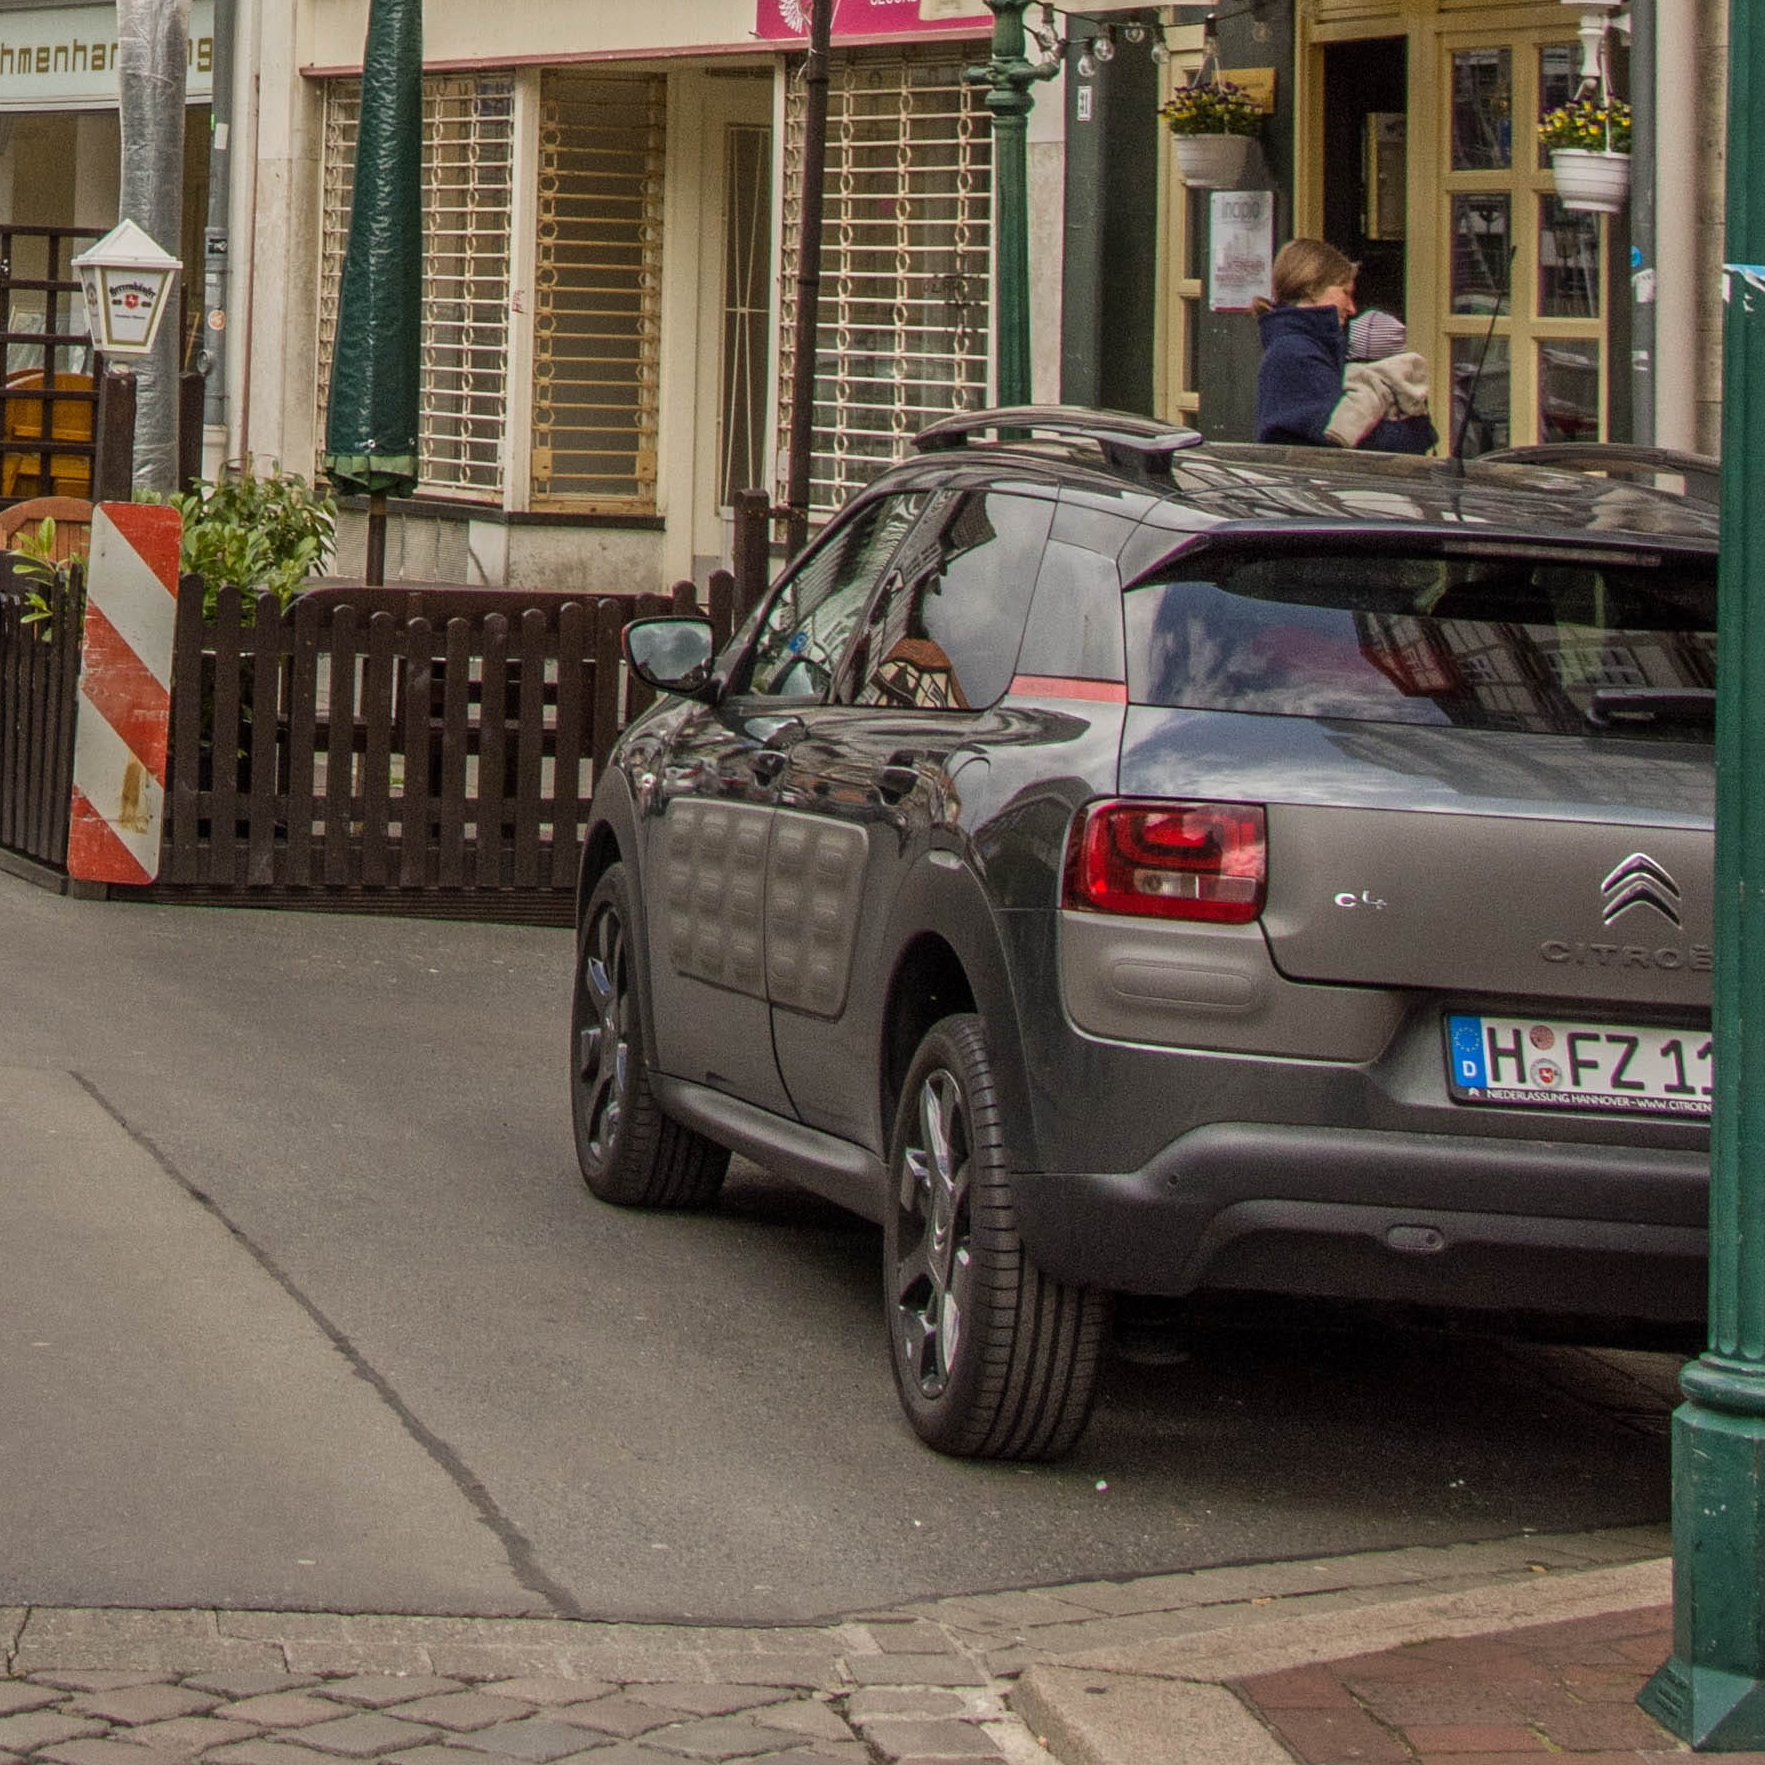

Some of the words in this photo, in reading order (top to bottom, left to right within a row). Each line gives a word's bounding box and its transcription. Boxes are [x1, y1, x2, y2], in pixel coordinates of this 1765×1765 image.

[1486, 1026, 1527, 1084] H
[1566, 1032, 1645, 1090] FZ
[1462, 1060, 1477, 1077] D
[1486, 1088, 1570, 1104] NIEDERLASSUNG
